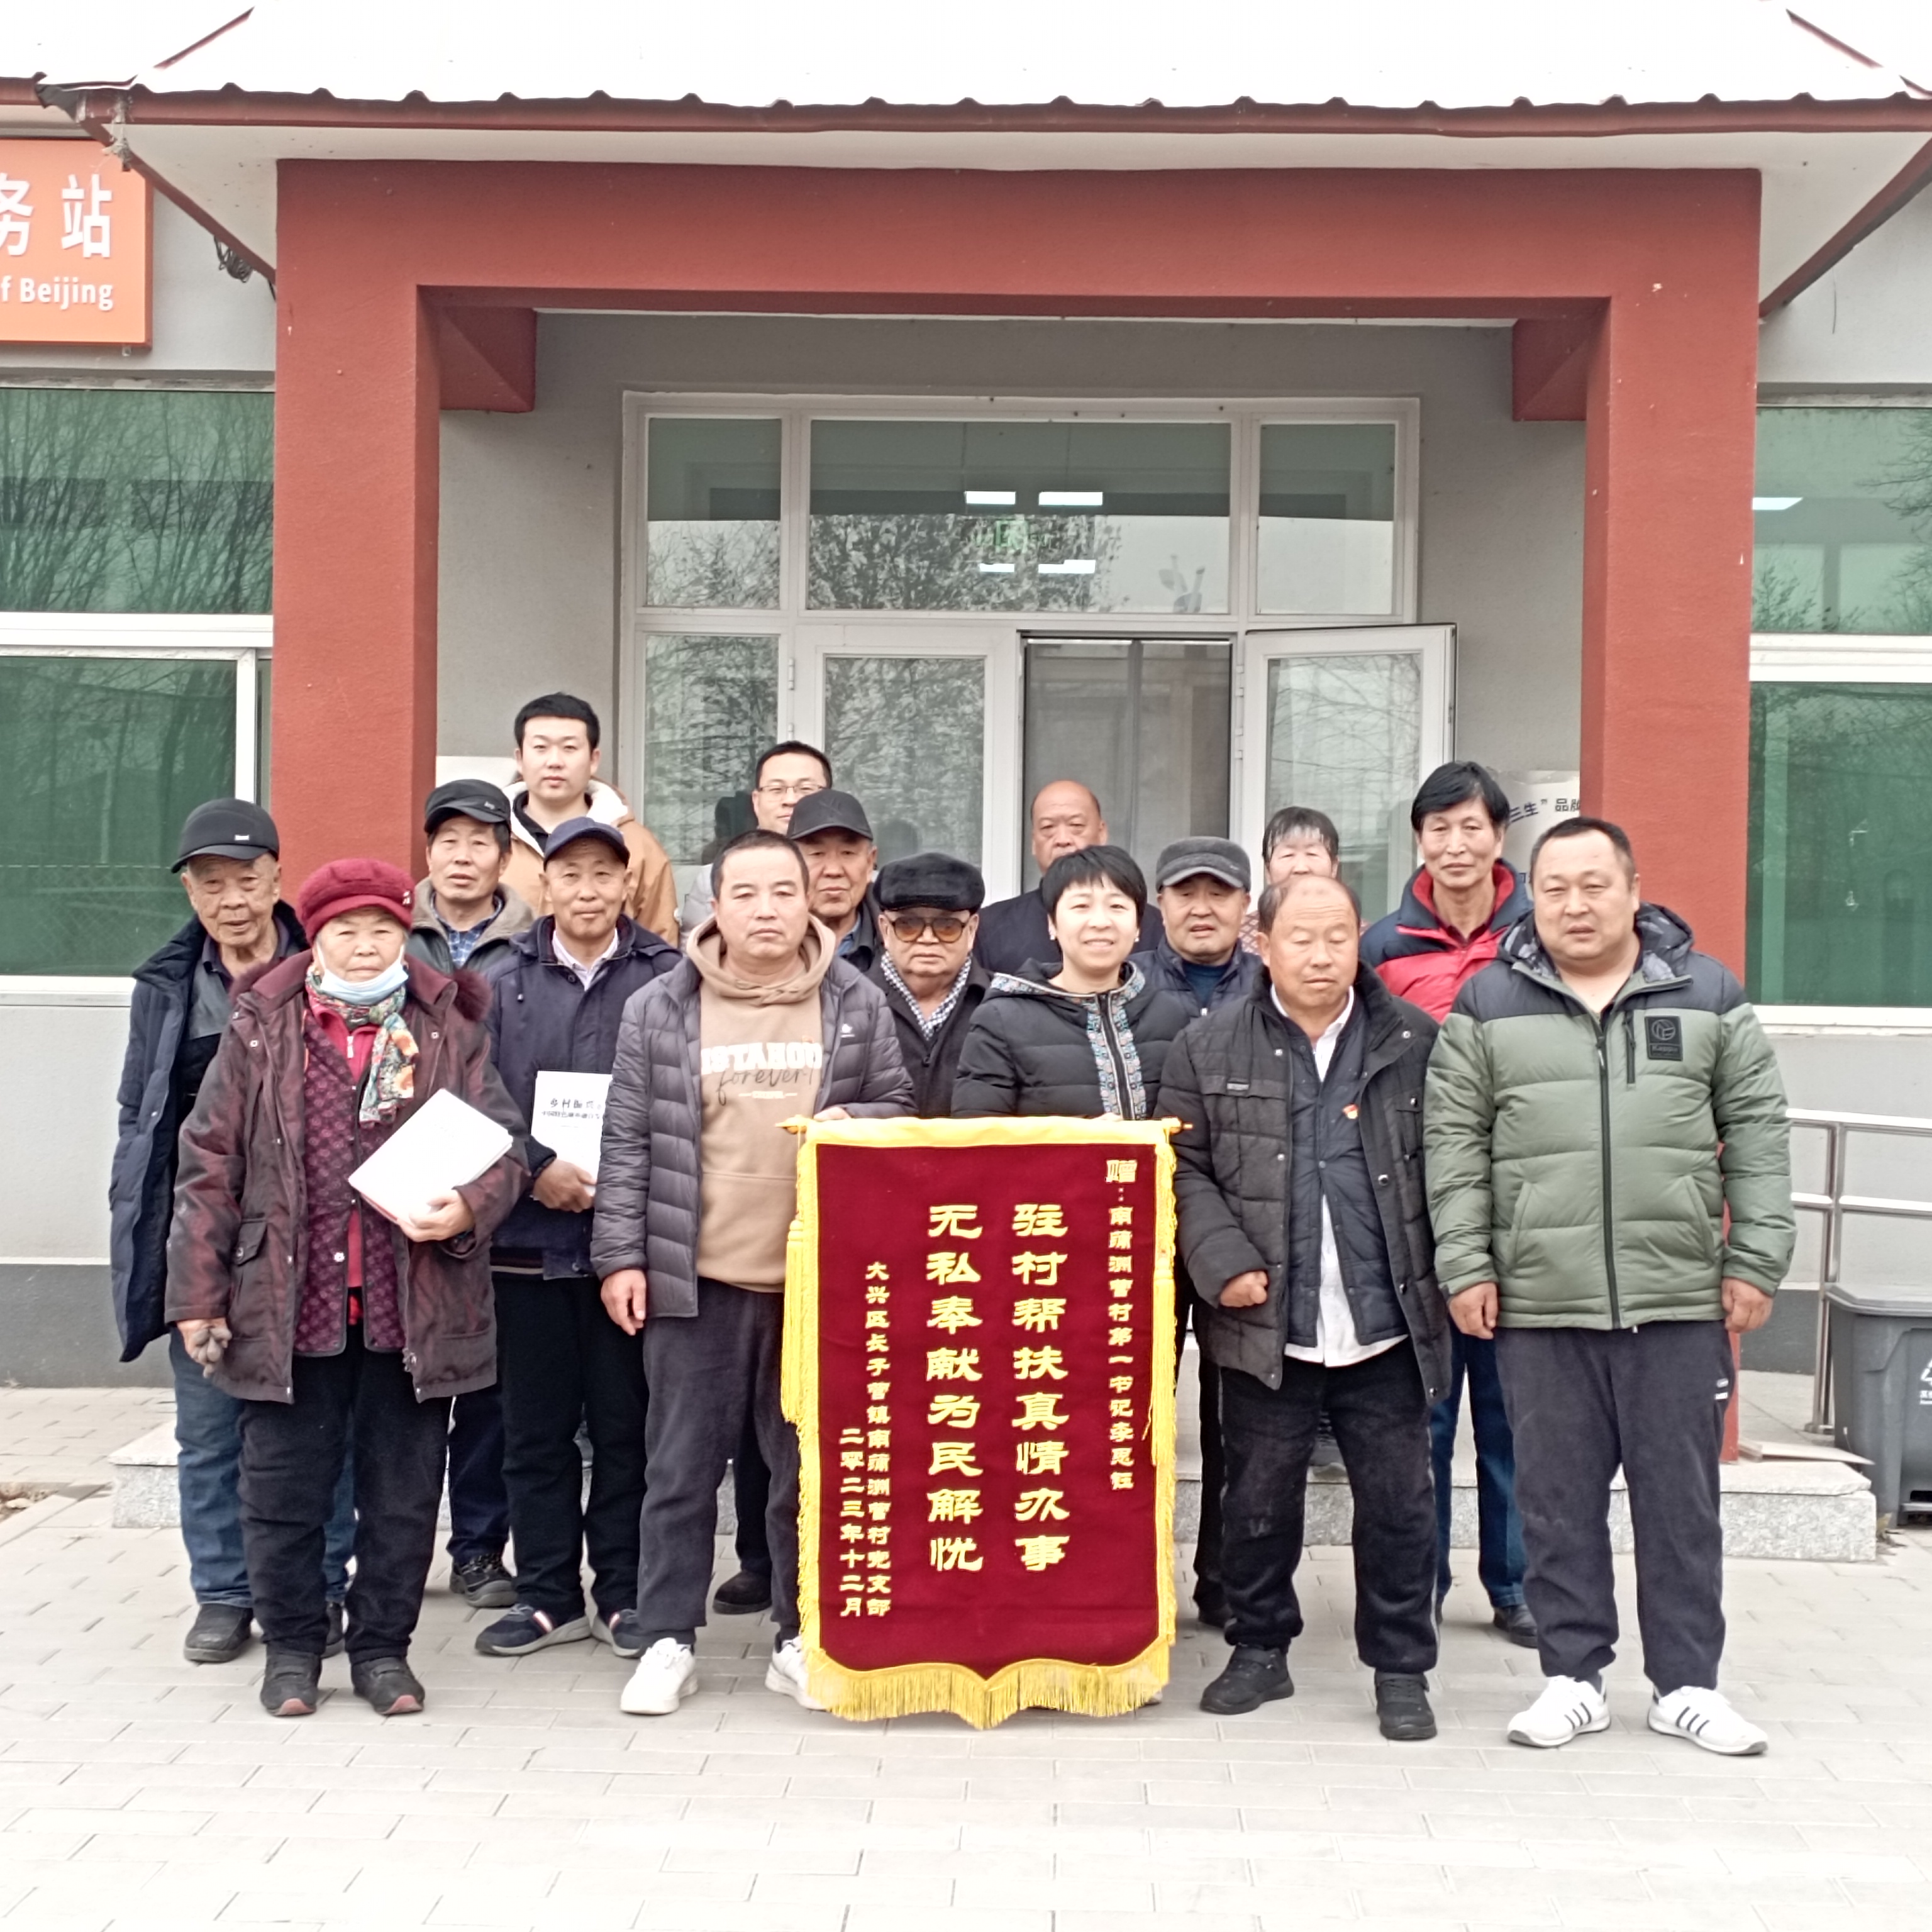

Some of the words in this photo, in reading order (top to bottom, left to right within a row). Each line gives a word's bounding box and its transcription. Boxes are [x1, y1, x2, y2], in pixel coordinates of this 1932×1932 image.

[0, 172, 113, 258] 务站
[0, 275, 13, 302] f
[19, 276, 114, 311] Beijing
[927, 1204, 984, 1572] 无私奉献为民解忧
[1013, 1204, 1069, 1571] 驻村帮扶真情办事
[840, 1428, 865, 1617] 二零二三年十二月
